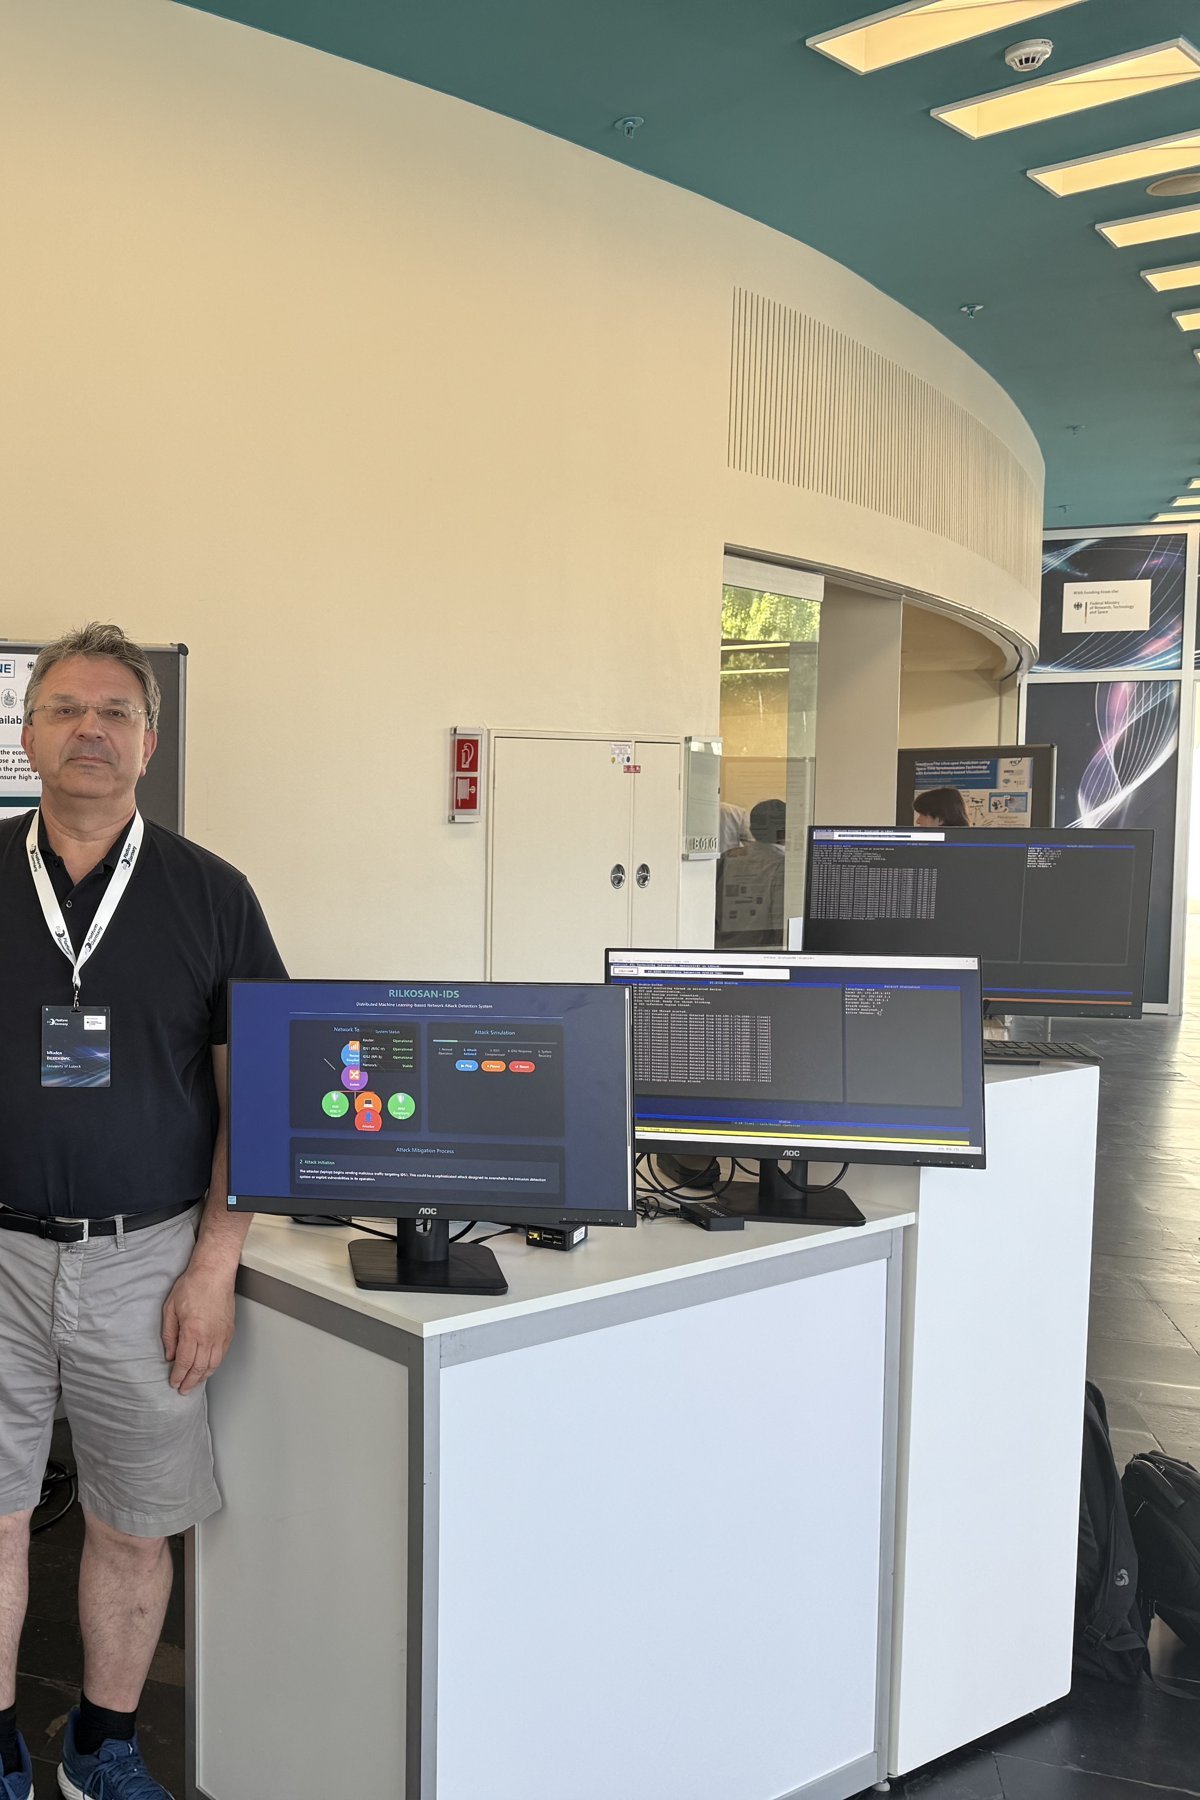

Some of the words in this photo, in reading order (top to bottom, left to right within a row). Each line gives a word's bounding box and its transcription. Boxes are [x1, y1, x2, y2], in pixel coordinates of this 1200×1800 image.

[88, 923, 98, 942] Platform
[91, 926, 103, 946] Germany
[388, 990, 460, 998] RILKOSAN-IDS
